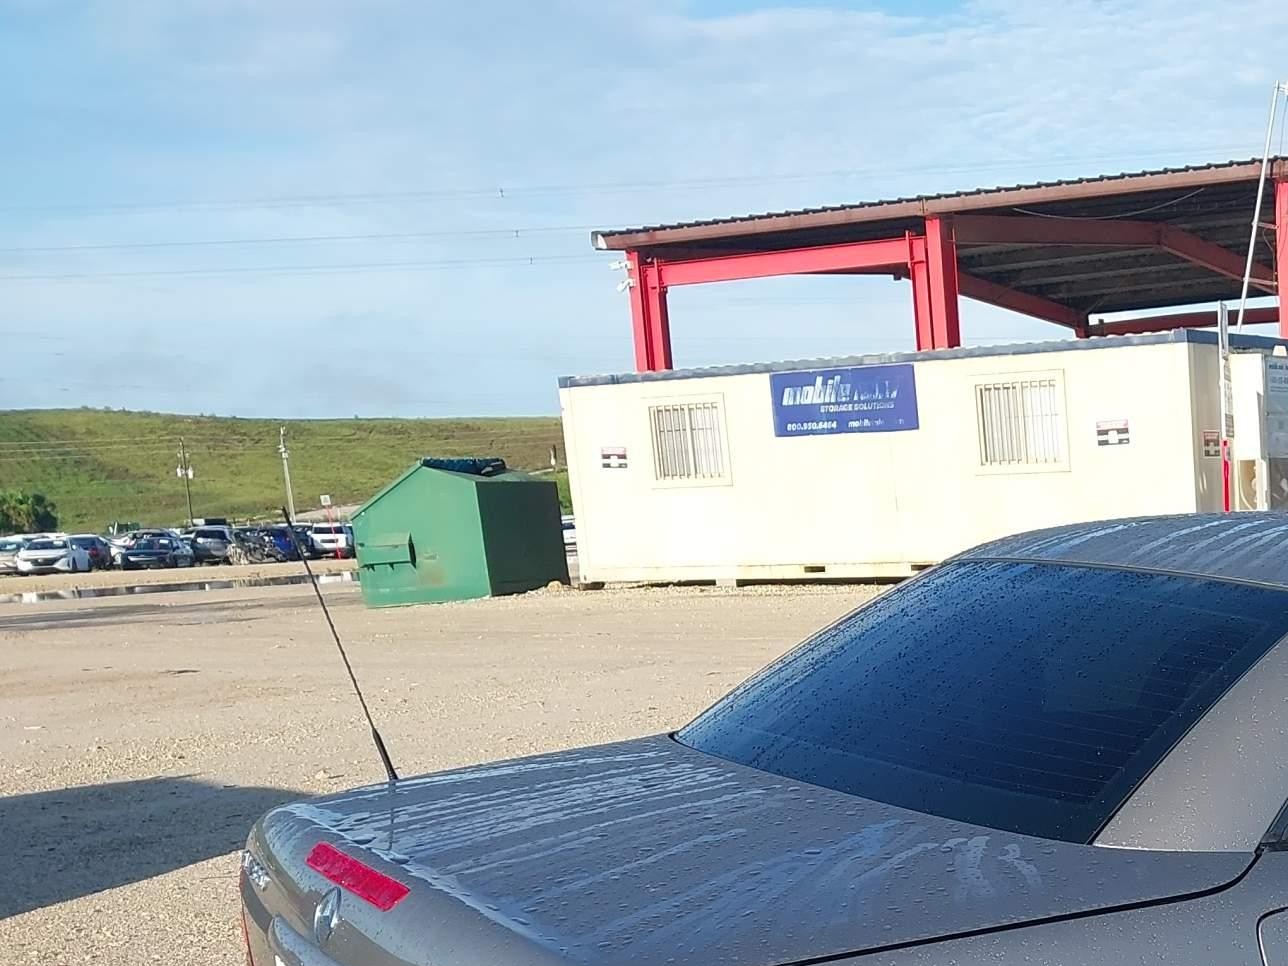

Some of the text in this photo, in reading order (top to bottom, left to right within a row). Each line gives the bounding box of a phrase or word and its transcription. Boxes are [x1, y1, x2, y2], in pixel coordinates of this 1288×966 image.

[781, 375, 851, 406] mobile
[820, 400, 895, 413] STORAGE SOLUTIONS
